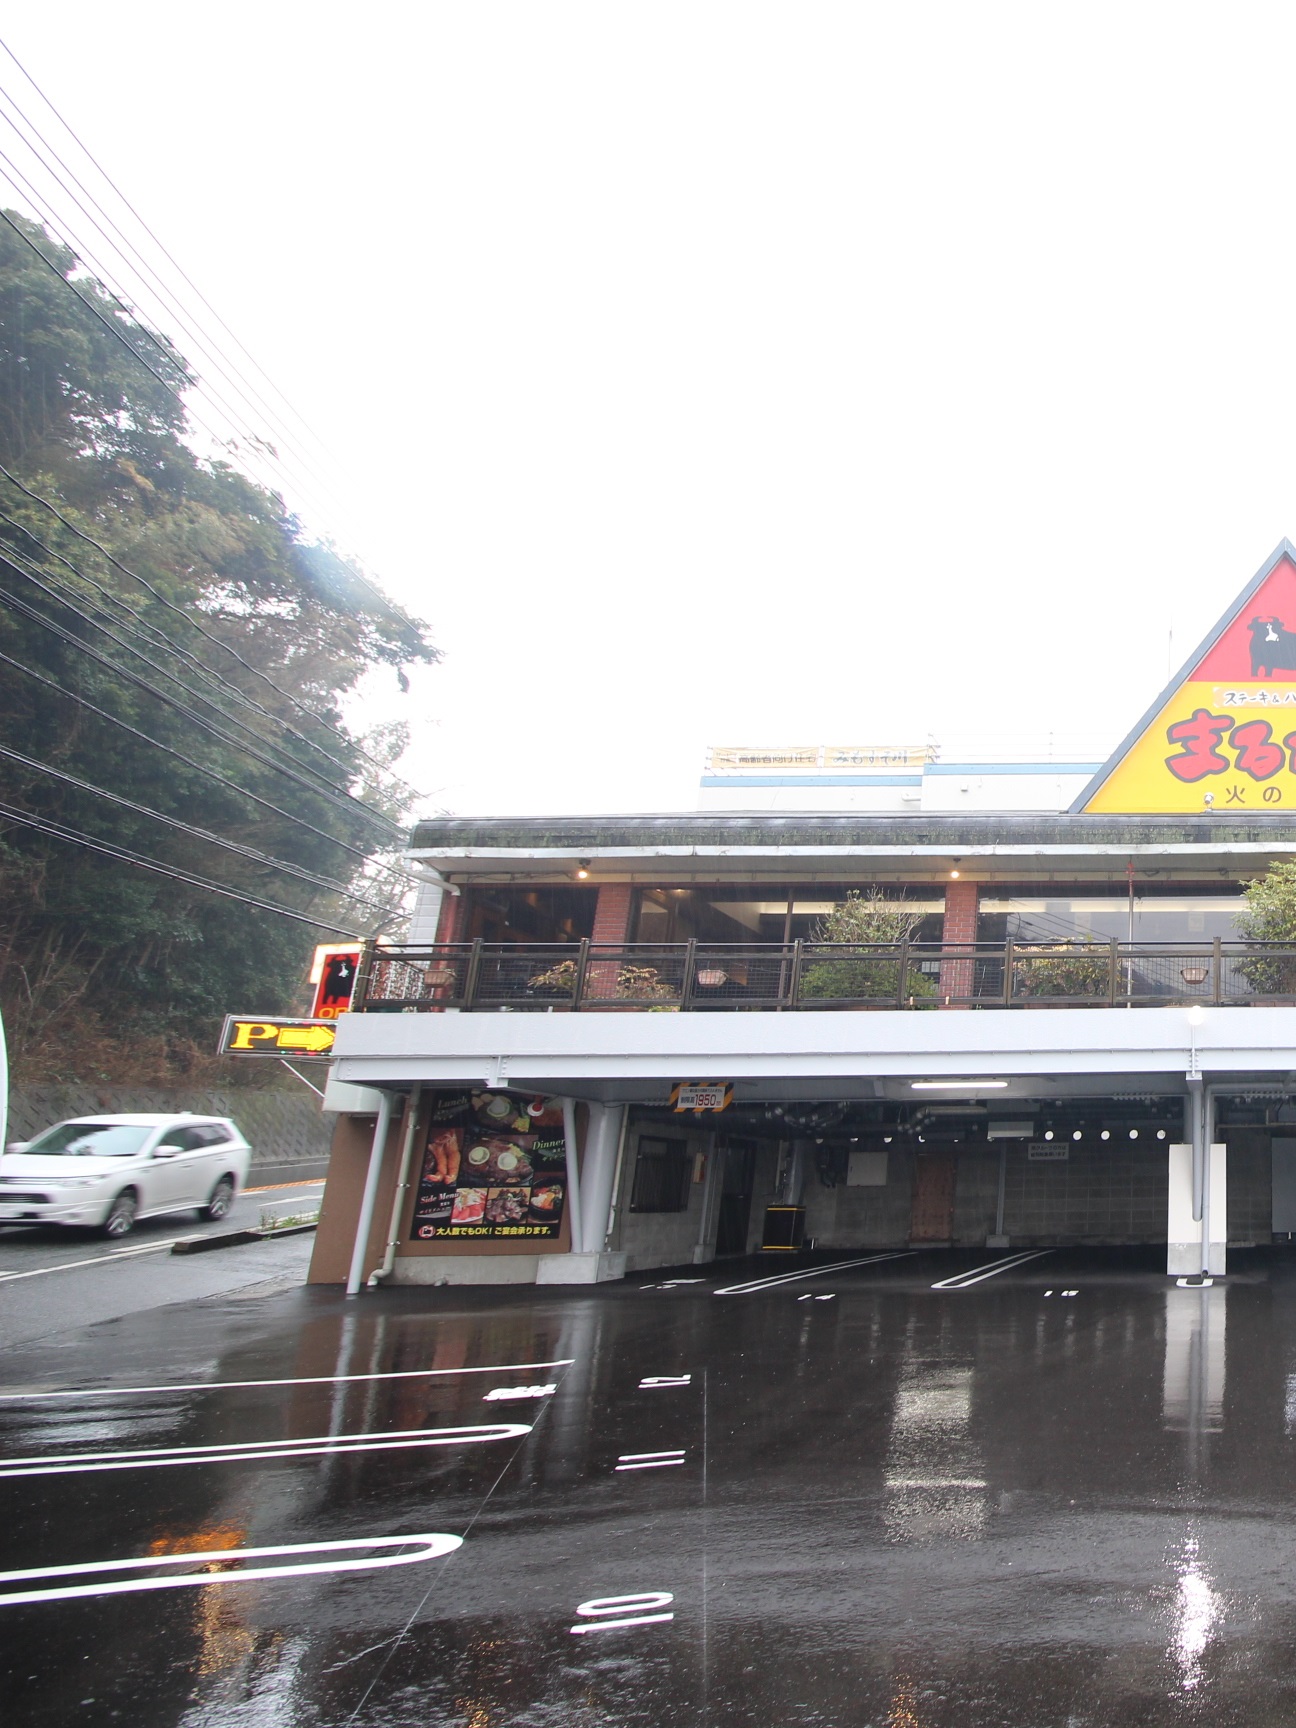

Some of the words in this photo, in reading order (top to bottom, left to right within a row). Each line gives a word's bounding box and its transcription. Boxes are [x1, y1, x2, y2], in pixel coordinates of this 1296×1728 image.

[230, 1023, 279, 1049] P
[695, 1094, 717, 1106] 1950
[532, 1139, 565, 1150] Dinner
[420, 1194, 437, 1204] Side
[570, 1591, 674, 1634] 10
